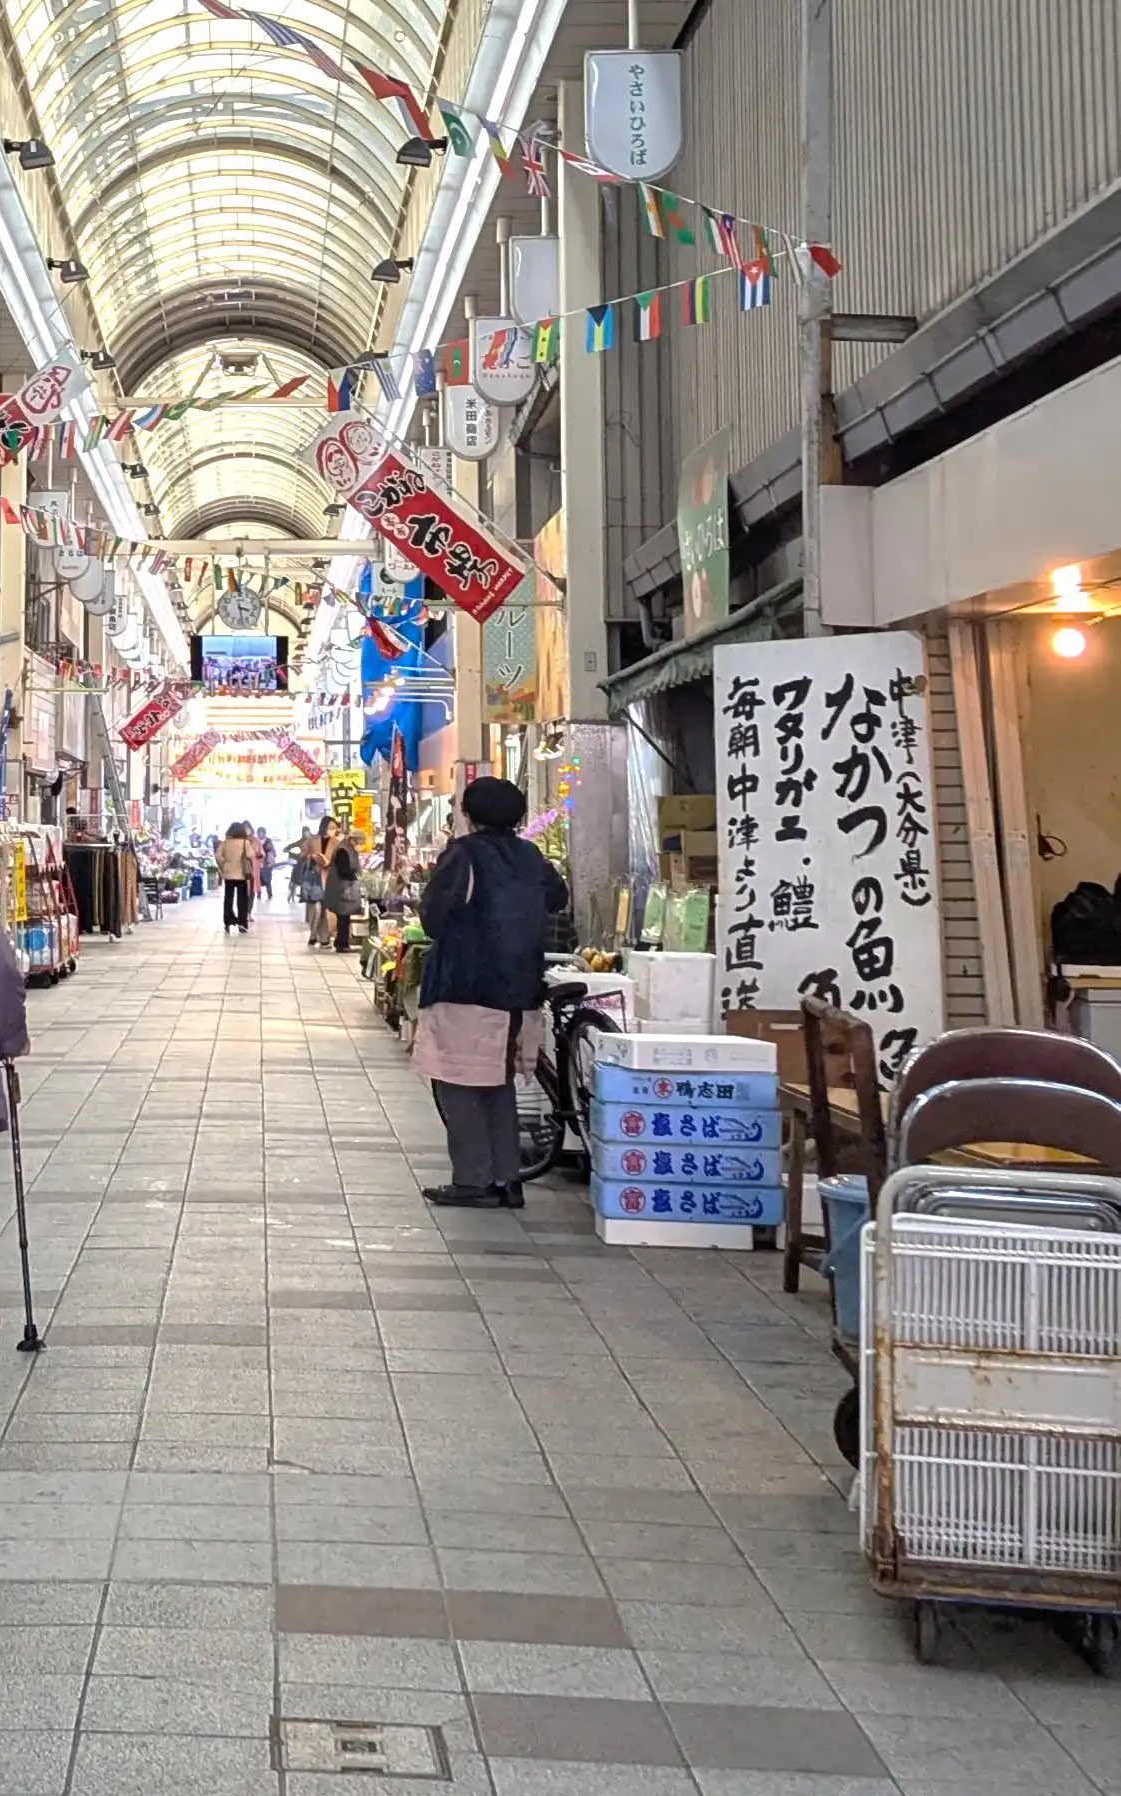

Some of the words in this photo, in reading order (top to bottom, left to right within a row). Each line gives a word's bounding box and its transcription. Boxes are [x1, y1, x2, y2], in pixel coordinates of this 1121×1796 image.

[629, 63, 648, 166] やさいひろば
[355, 467, 426, 518] こがね
